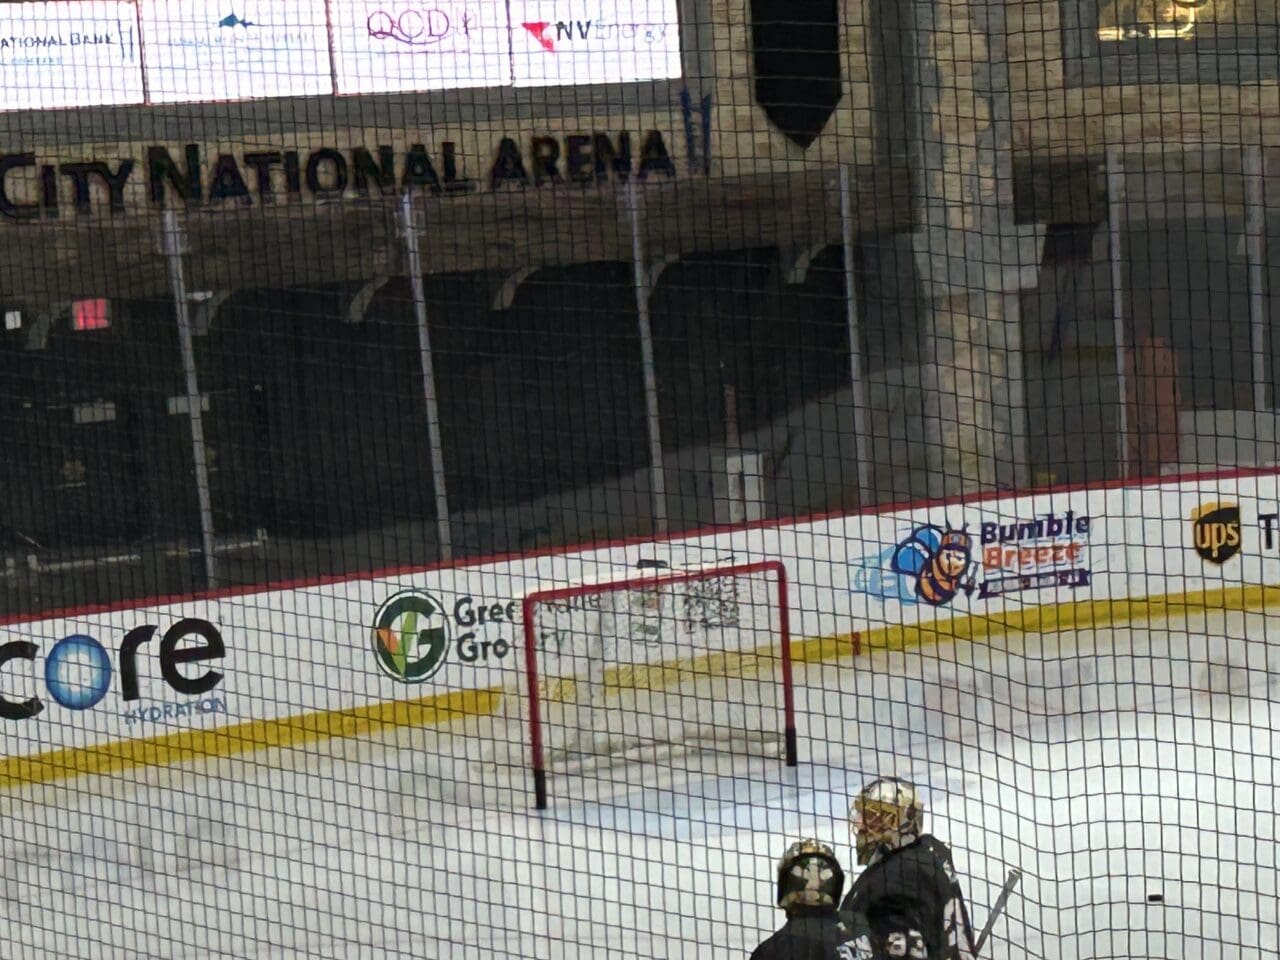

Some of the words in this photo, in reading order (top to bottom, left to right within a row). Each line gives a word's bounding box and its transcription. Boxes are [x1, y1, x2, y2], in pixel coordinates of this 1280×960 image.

[143, 139, 477, 206] NATIONAL
[490, 129, 676, 188] ARENA
[980, 510, 1091, 545] Bumble
[1195, 522, 1240, 558] ups
[983, 541, 1083, 571] Breeze
[455, 596, 516, 627] Gree
